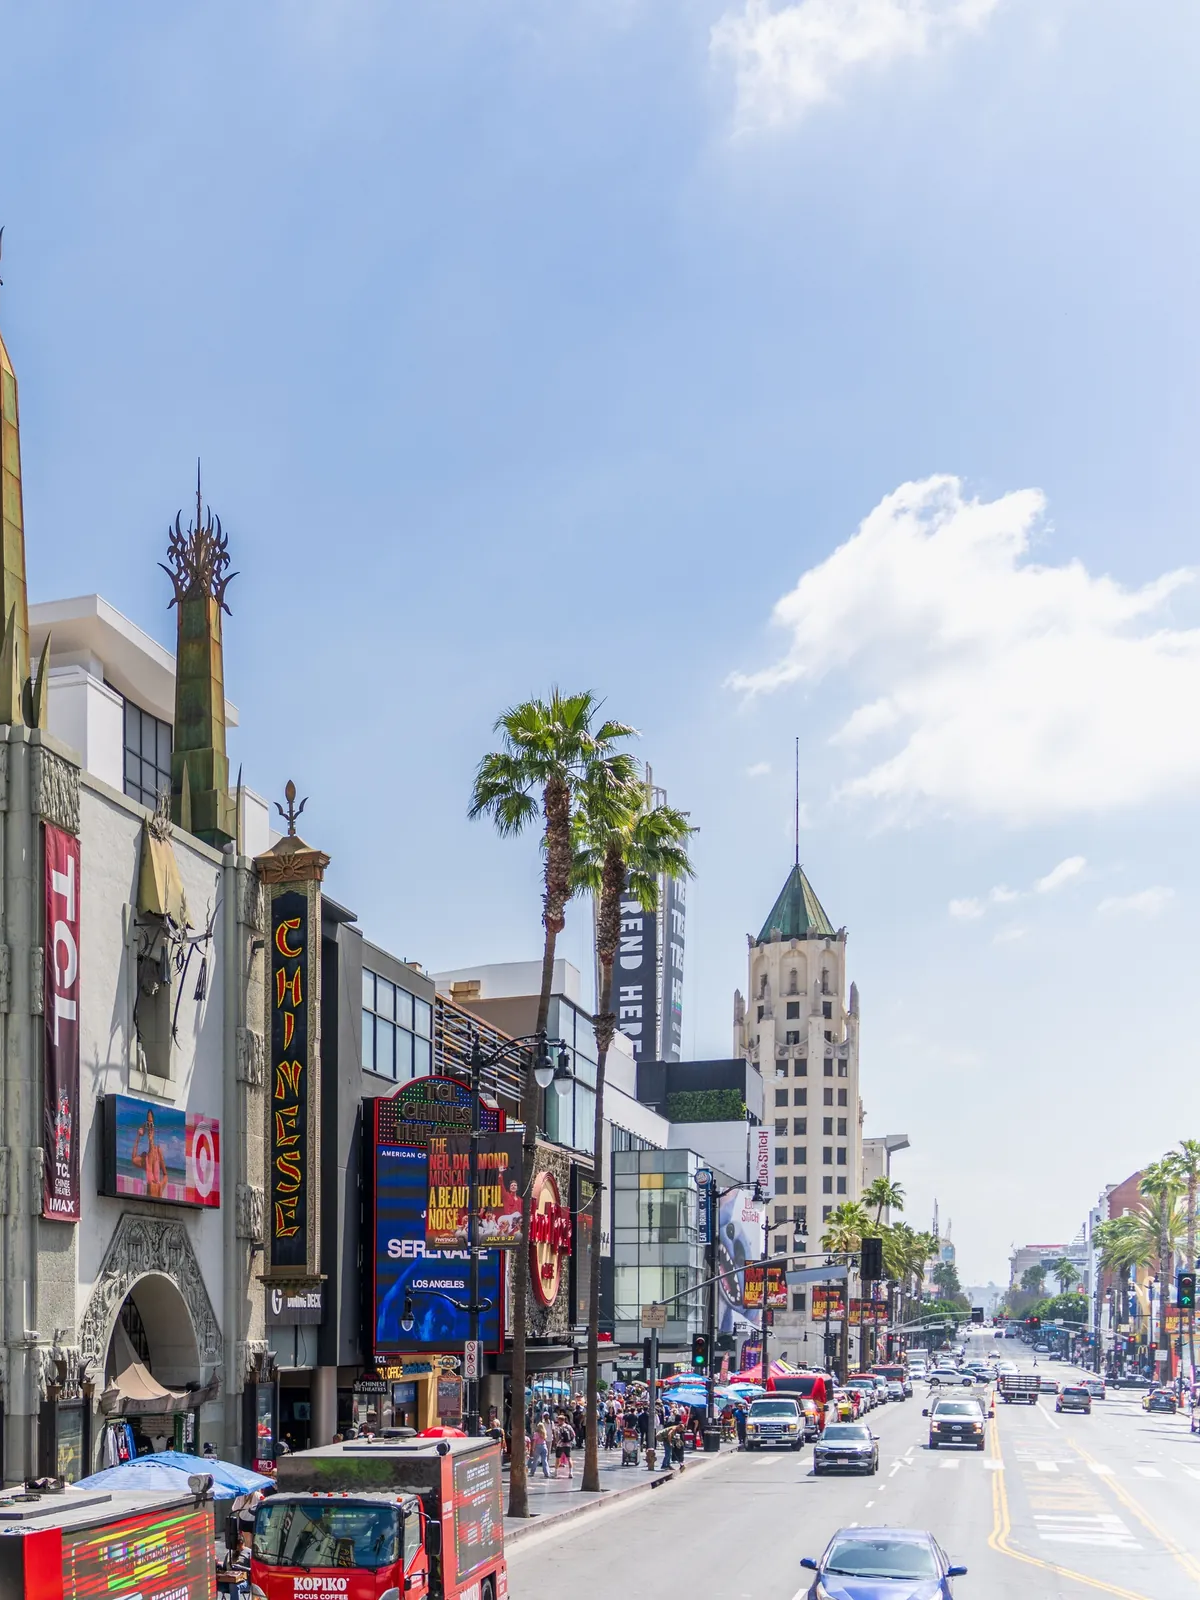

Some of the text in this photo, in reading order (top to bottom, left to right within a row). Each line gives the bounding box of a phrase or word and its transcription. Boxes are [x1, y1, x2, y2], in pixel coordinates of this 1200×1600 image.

[52, 854, 79, 1047] TCL
[274, 917, 303, 1240] CHINESE
[425, 1082, 460, 1102] TCL
[403, 1101, 473, 1124] CHINES
[381, 1150, 416, 1159] AMERICAN
[429, 1137, 448, 1154] THE
[429, 1152, 509, 1171] NEIL DIAMOND
[429, 1169, 468, 1187] MUSICAL
[49, 1197, 75, 1213] IMAX
[429, 1185, 504, 1208] A BEAUTIFUL
[428, 1208, 460, 1231] NOISE
[387, 1238, 489, 1260] SERE
[412, 1279, 465, 1289] LOS ANGELES
[374, 1355, 387, 1364] TCL
[293, 1577, 347, 1592] KOPIKO
